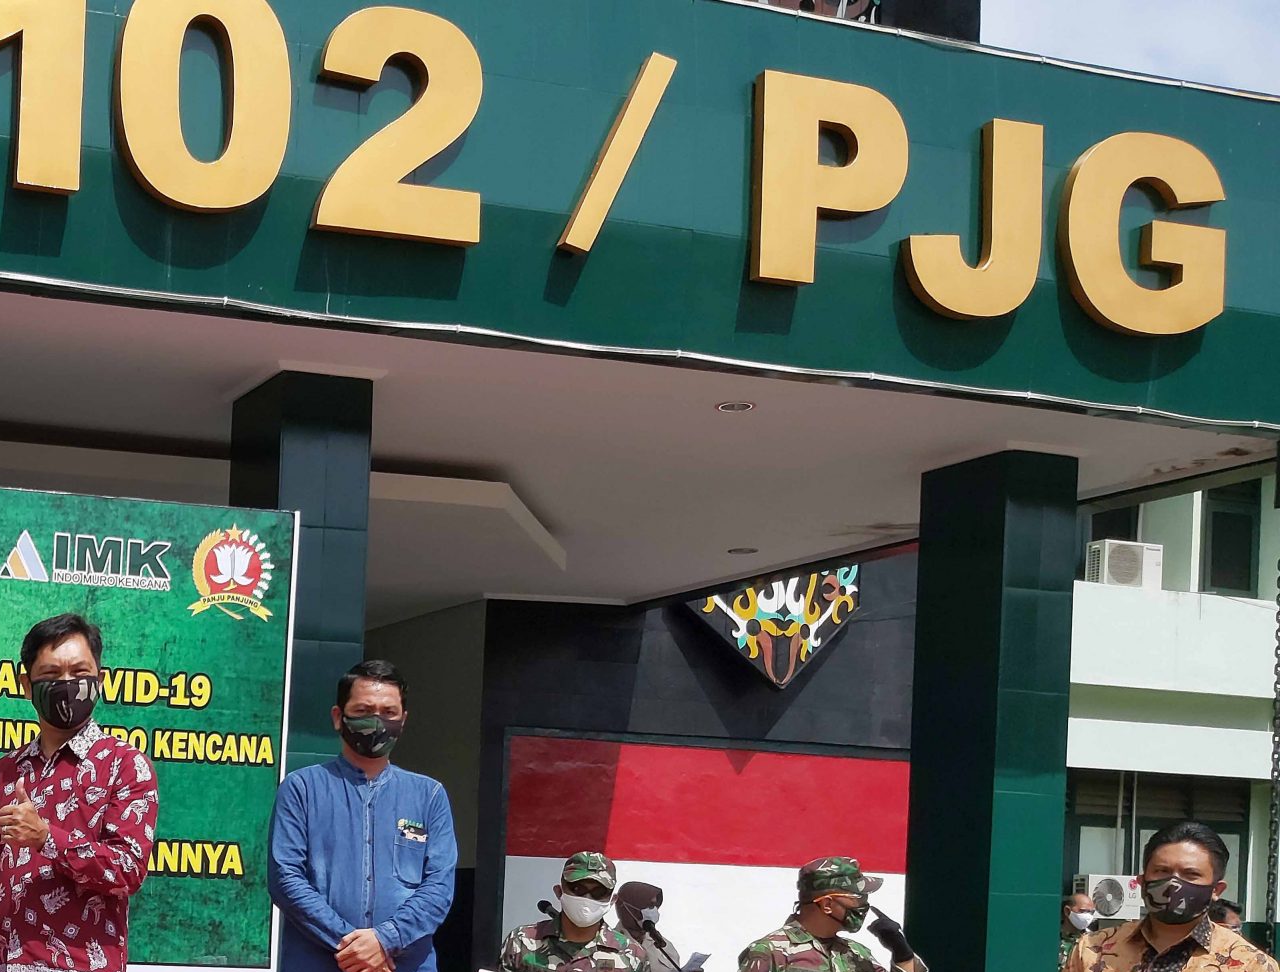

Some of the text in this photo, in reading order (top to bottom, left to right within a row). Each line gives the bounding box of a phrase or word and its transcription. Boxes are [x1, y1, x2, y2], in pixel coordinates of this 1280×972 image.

[752, 69, 1226, 336] PJG
[52, 532, 171, 579] IMK
[53, 572, 170, 591] INDO MURO KENCANA
[202, 594, 260, 609] PANJU PANJUNG
[101, 670, 211, 707] VID-19
[153, 732, 274, 765] KENCANA
